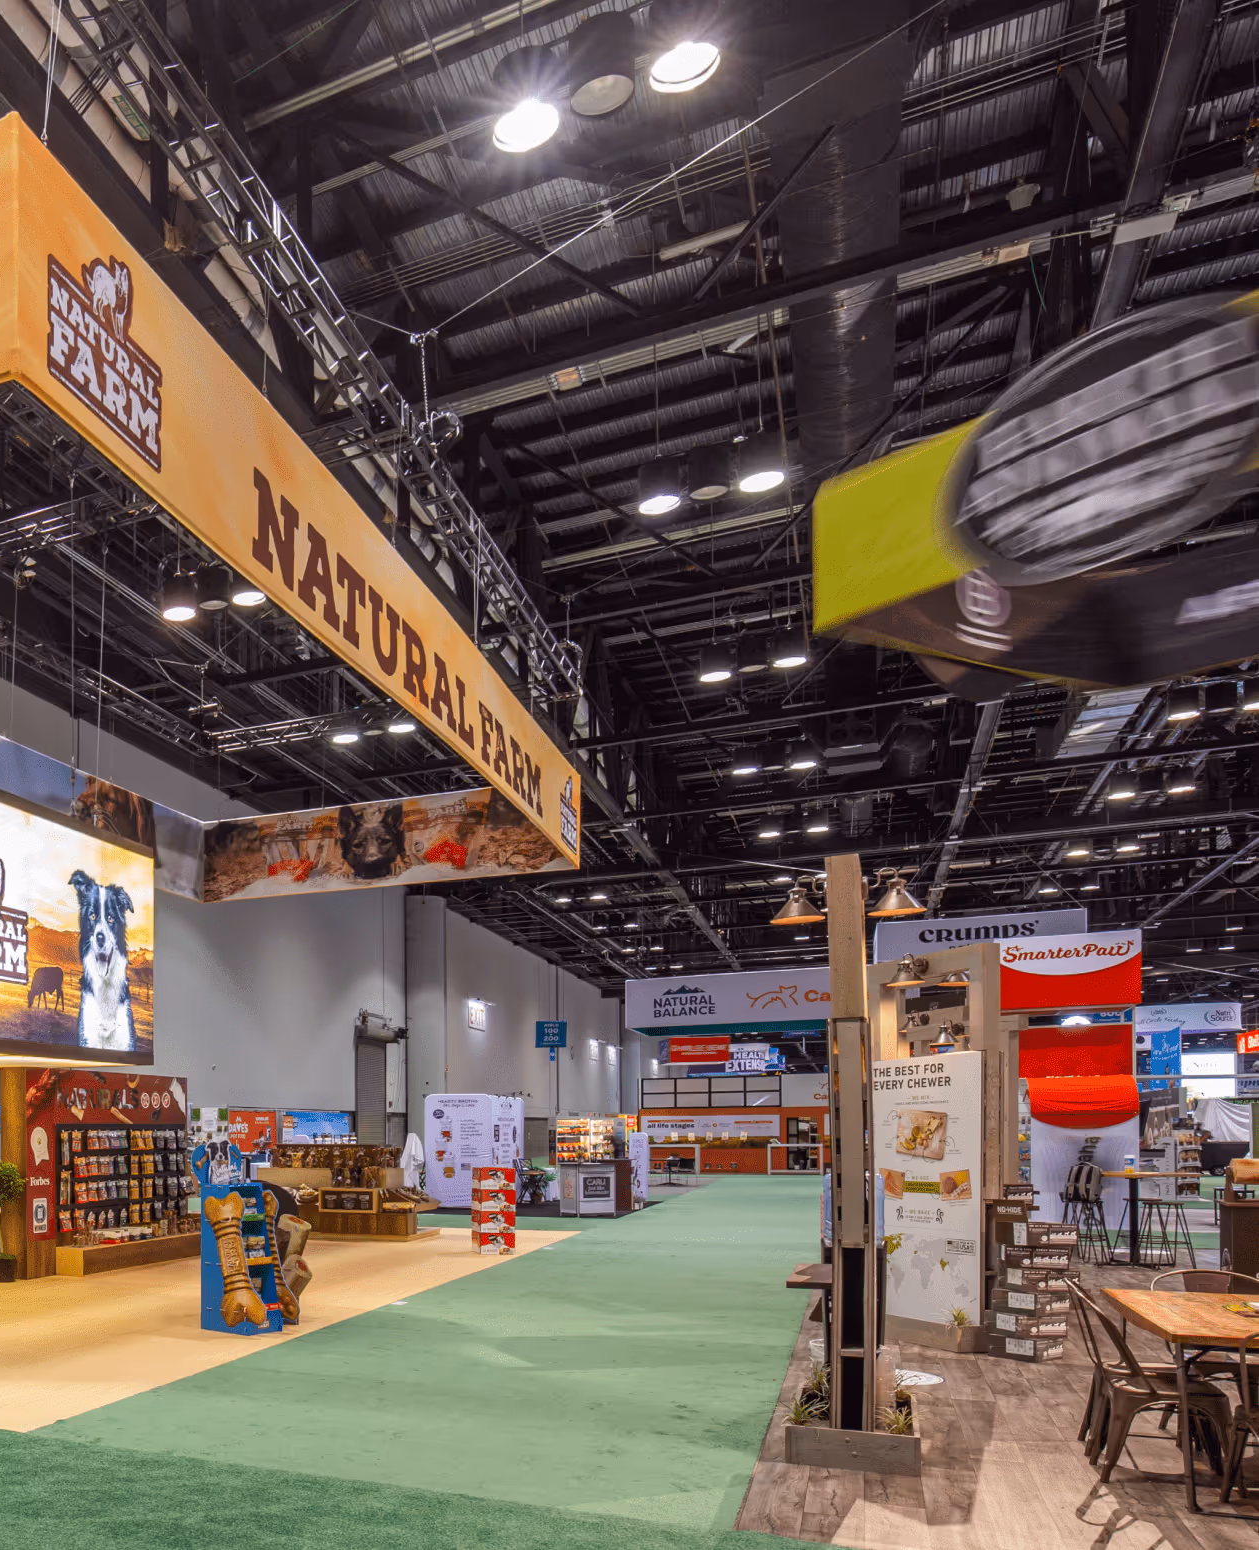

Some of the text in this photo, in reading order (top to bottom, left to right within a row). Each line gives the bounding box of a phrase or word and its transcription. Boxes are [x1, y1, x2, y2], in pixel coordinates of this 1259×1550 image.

[50, 277, 159, 409] NATURAL
[50, 311, 158, 455] FARM
[252, 466, 543, 819] NATURAL FARM
[1002, 939, 1135, 963] SmarterPaw
[653, 994, 716, 1009] NATURAL
[804, 990, 830, 1002] Ca
[653, 1006, 717, 1018] BALANCE
[873, 1063, 945, 1078] THE BEST FOR
[873, 1076, 952, 1091] EVERY CHEWER
[56, 1087, 139, 1110] NATURALS
[30, 1177, 50, 1187] Forbes
[996, 1205, 1022, 1214] NO-HIDE
